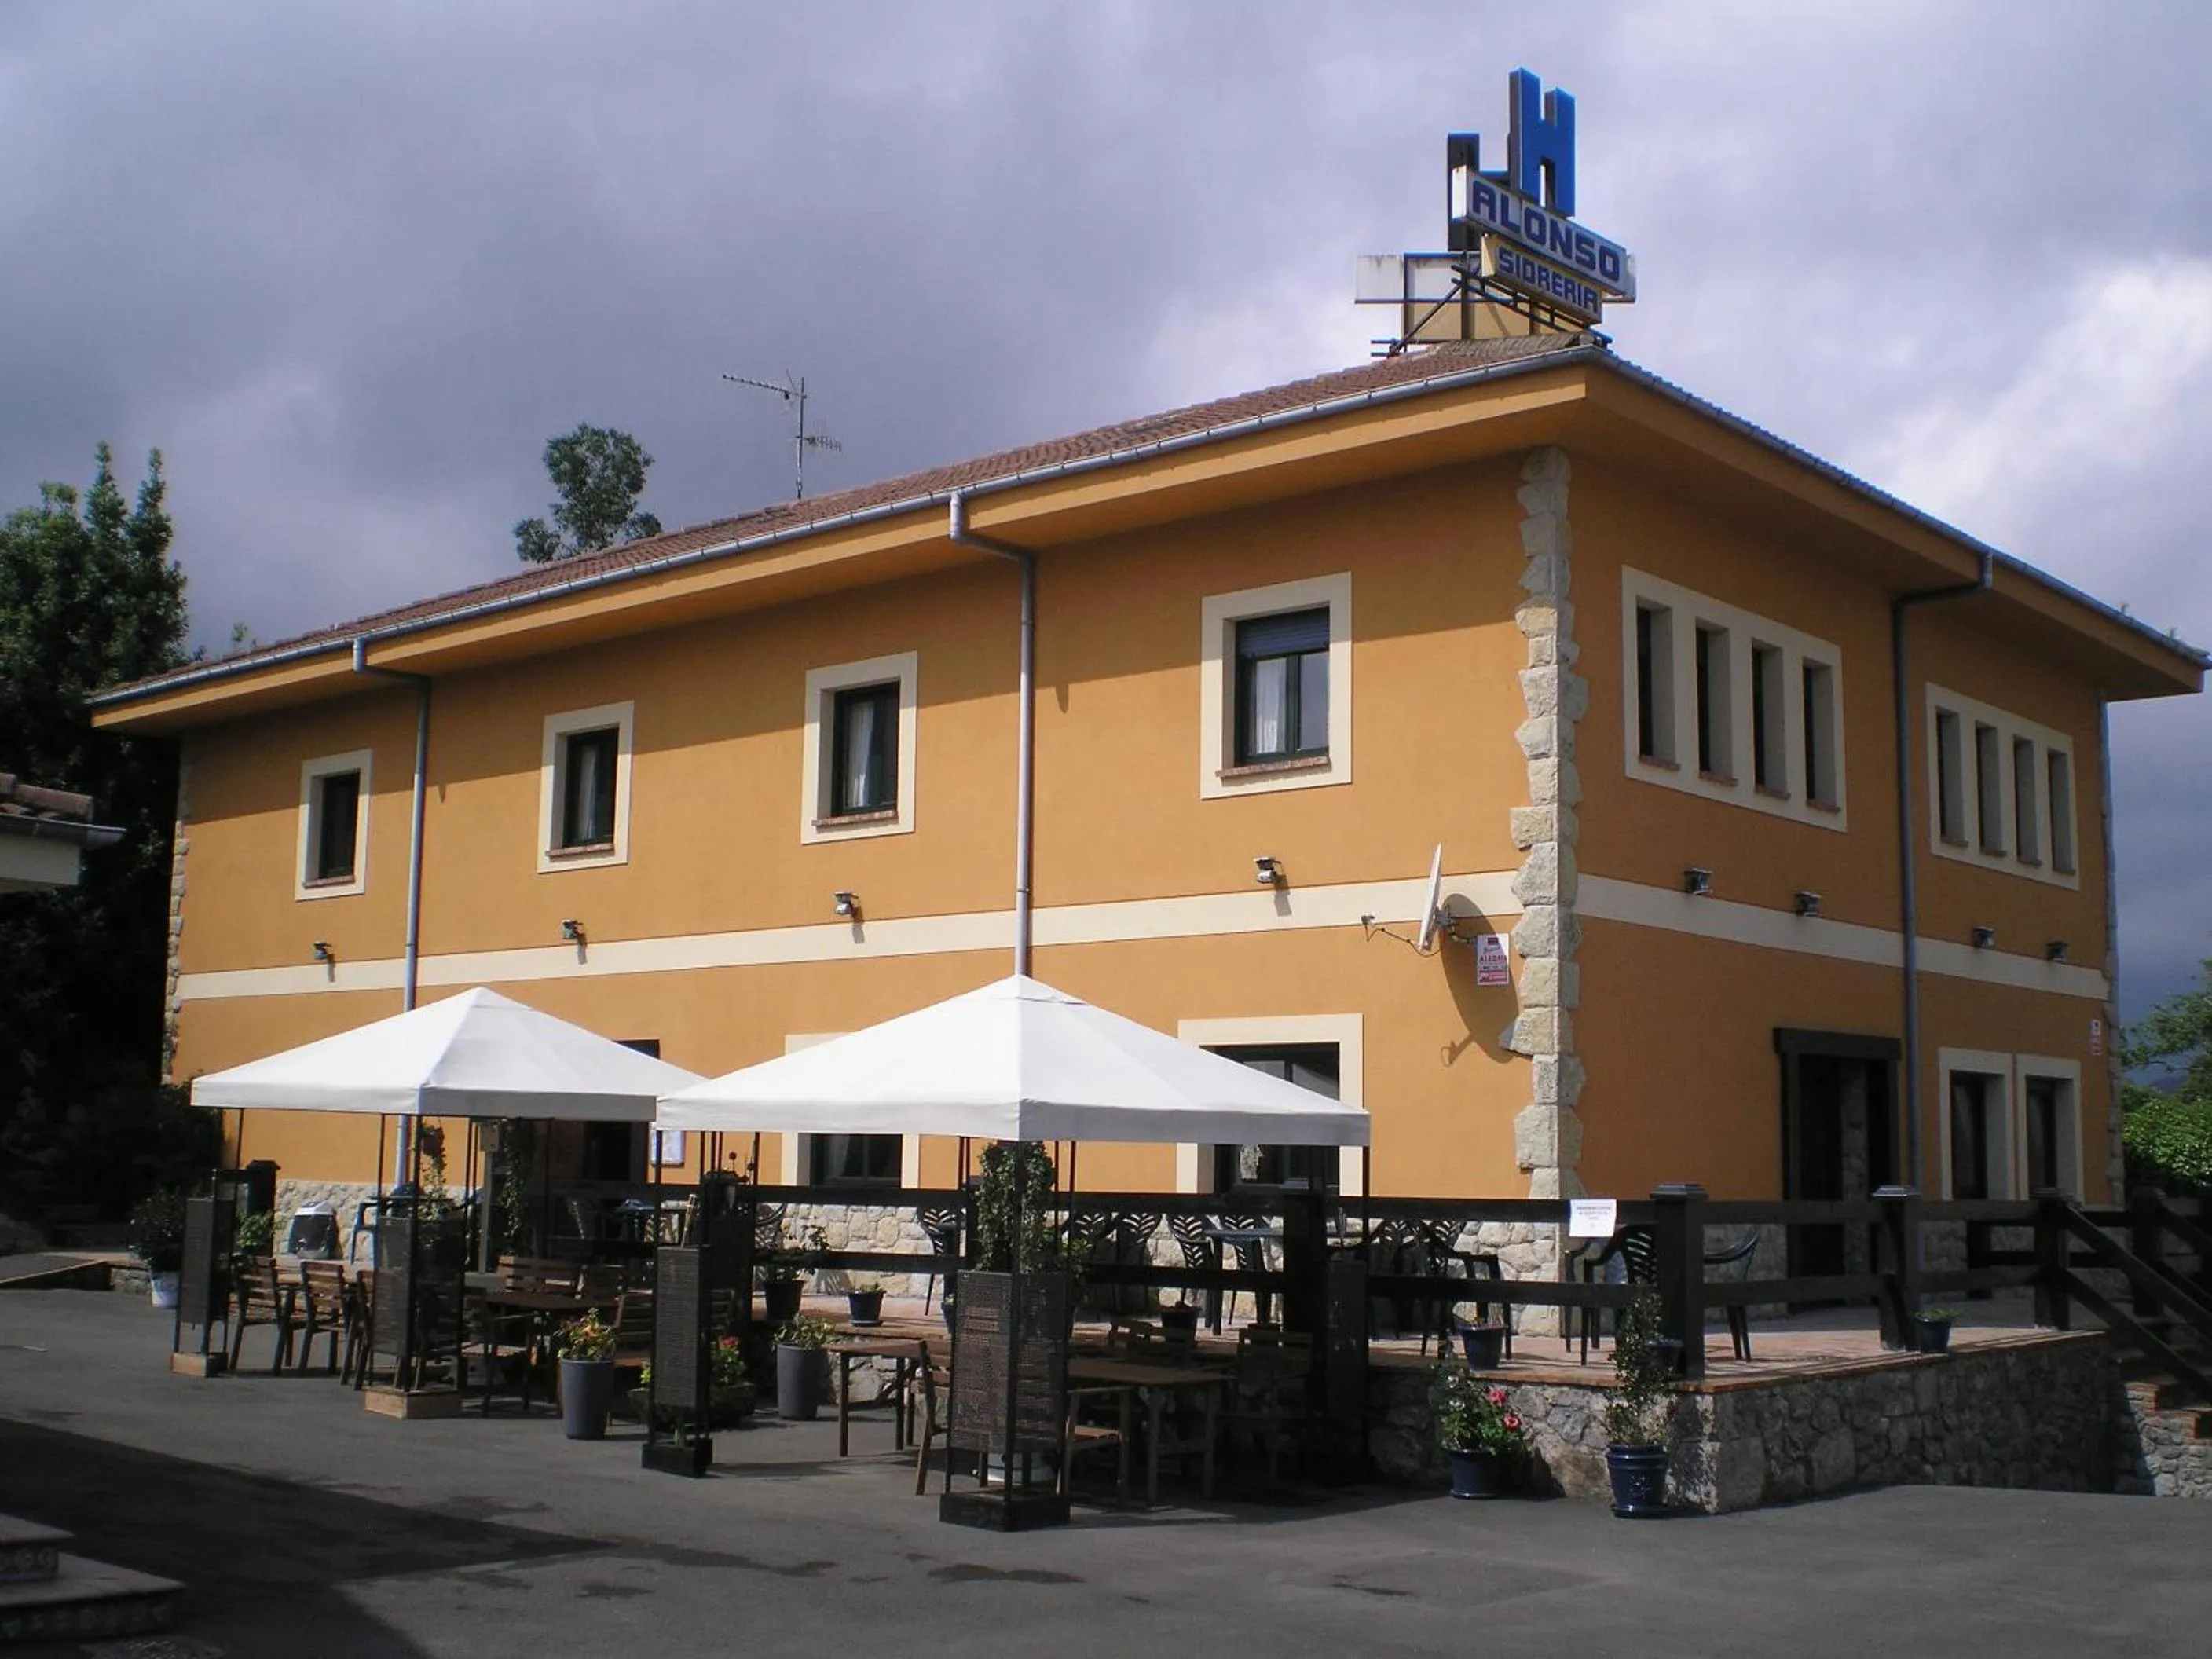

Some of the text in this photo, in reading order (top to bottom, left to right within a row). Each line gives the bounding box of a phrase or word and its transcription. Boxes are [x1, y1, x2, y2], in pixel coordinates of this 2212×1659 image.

[1510, 66, 1576, 218] H
[1472, 180, 1621, 282] ALONSO
[1498, 245, 1599, 314] SIDRERIA
